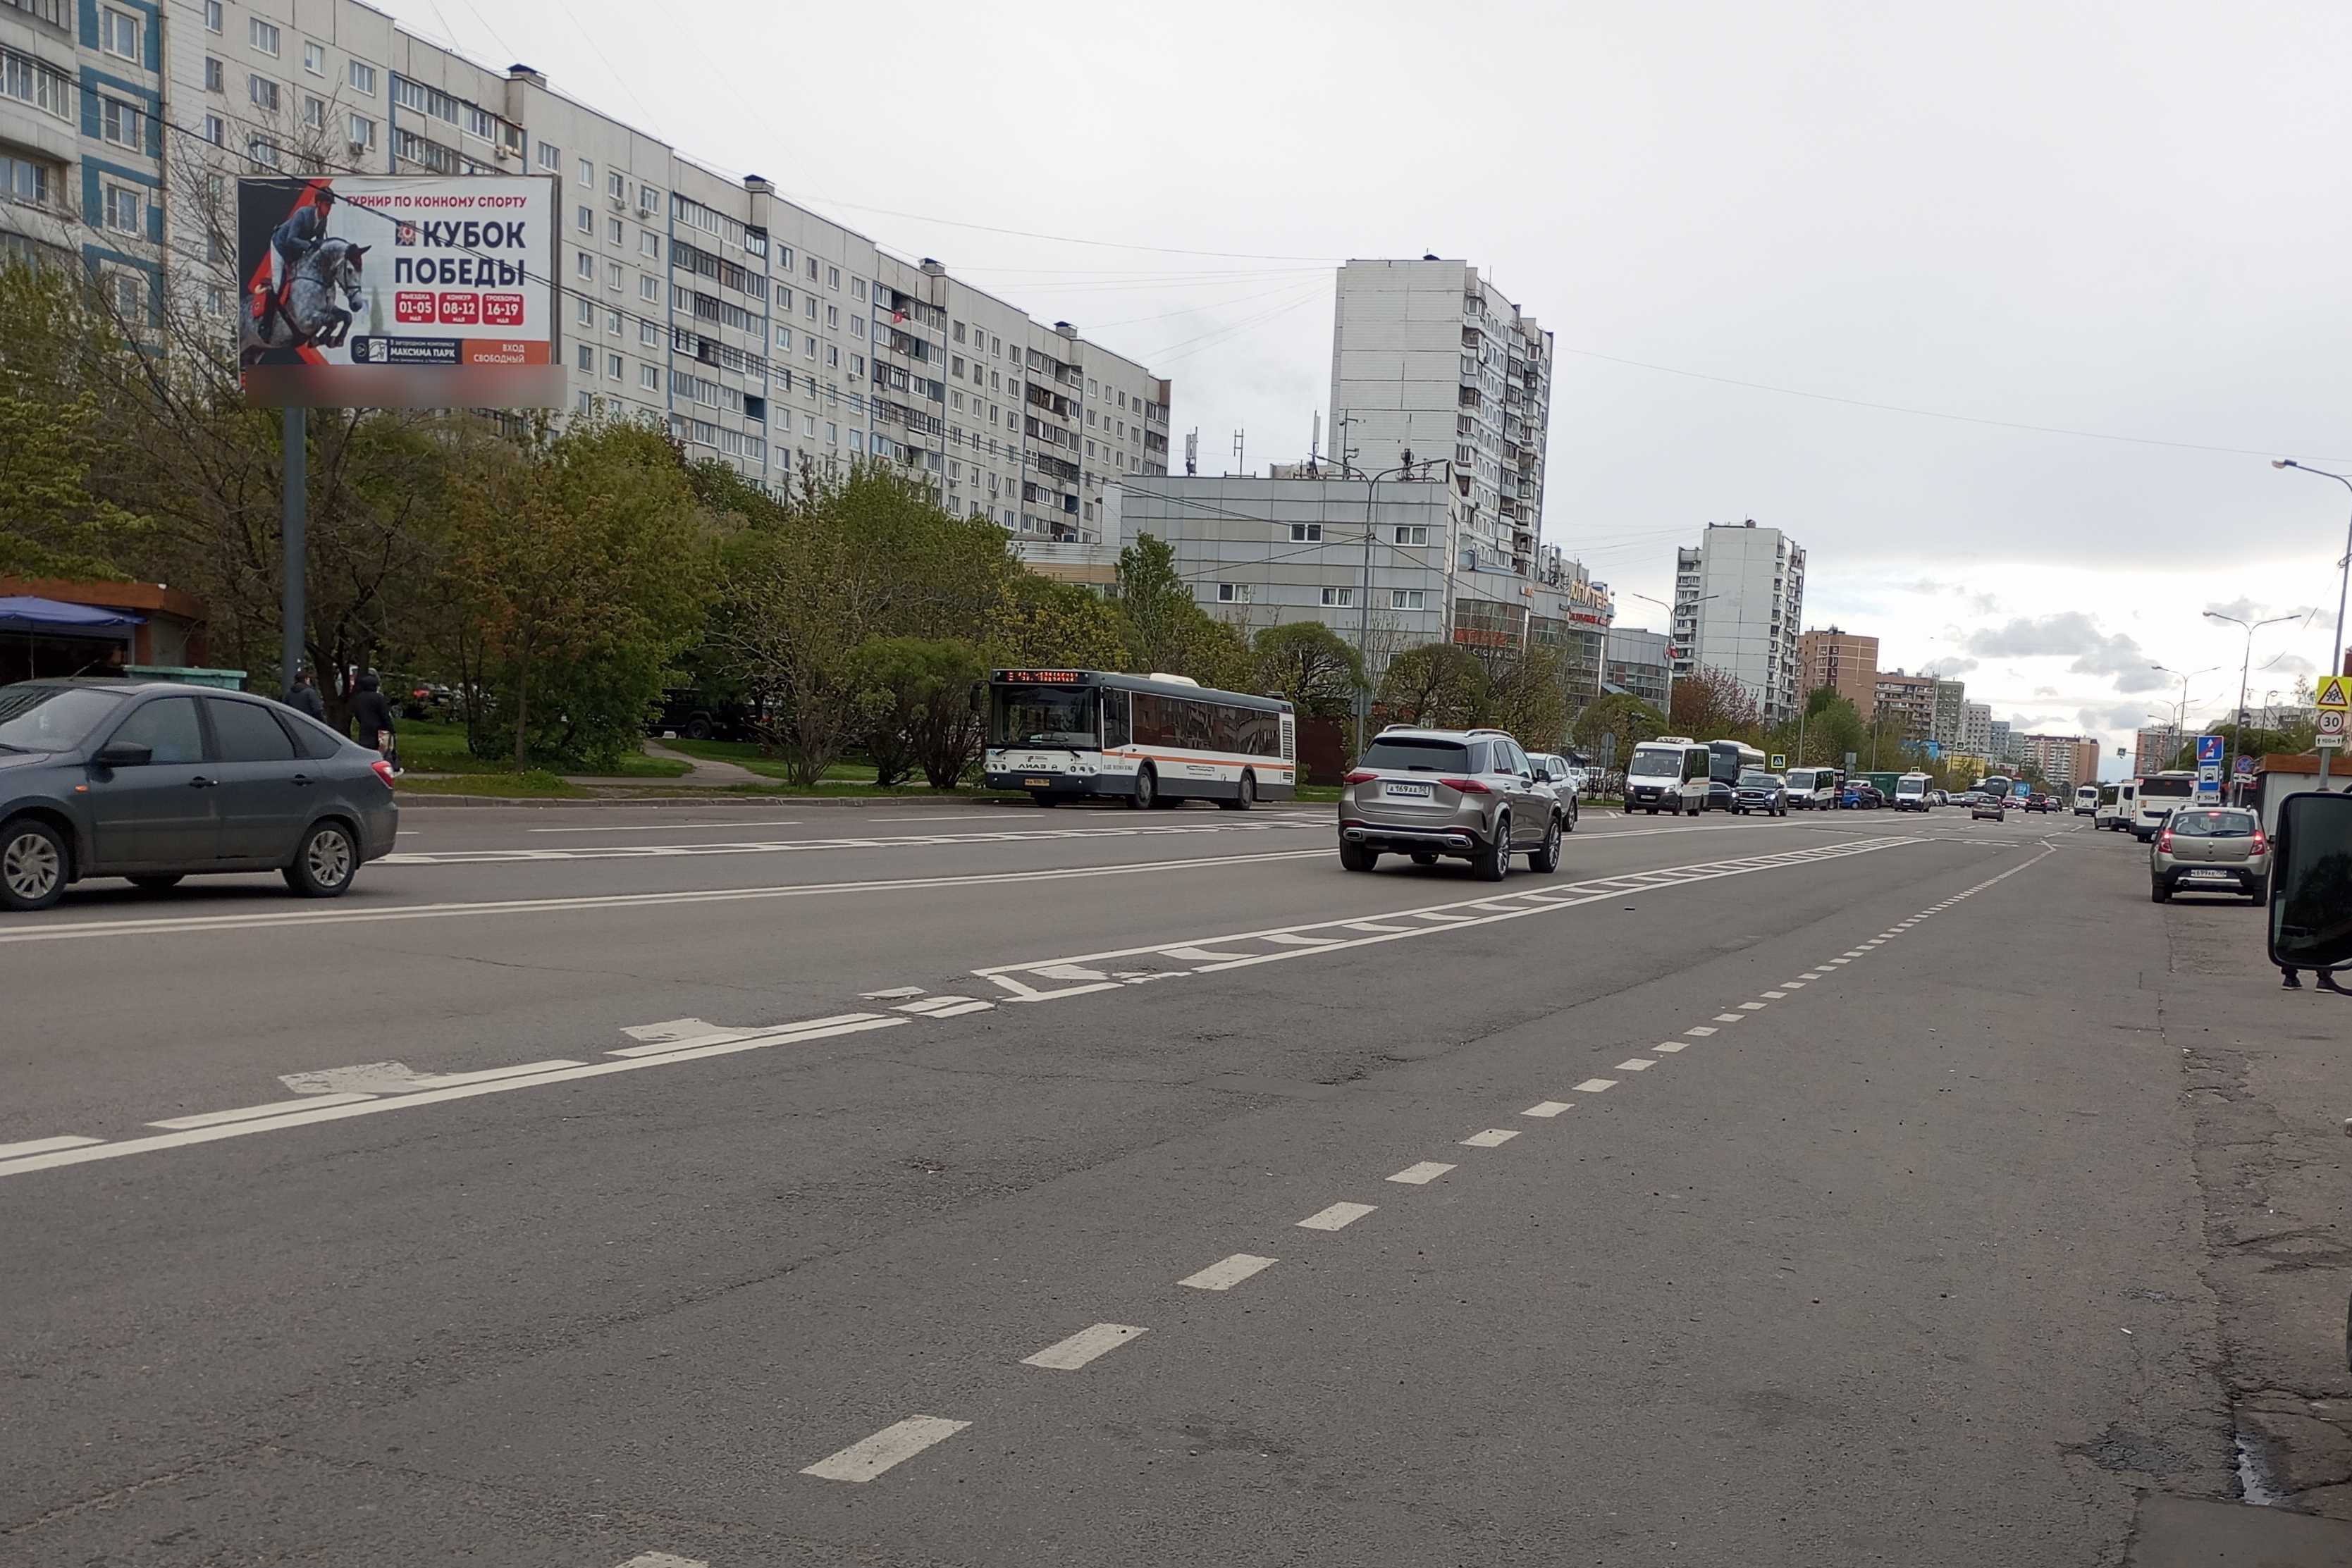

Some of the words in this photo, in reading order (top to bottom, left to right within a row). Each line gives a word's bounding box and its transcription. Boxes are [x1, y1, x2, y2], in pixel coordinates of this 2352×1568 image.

[345, 195, 392, 207] ТУРНИР
[395, 196, 412, 207] ПО
[414, 196, 476, 208] КОННОМУ
[478, 196, 527, 208] СПОРТУ
[423, 221, 527, 248] КУБОК
[395, 257, 525, 288] ПОБЕДЫ
[399, 301, 432, 314] 01-05
[443, 302, 476, 315] 08-12
[486, 303, 519, 316] 16-19
[390, 347, 431, 357] МАКСИМА
[432, 348, 455, 357] ПАРК
[502, 343, 525, 352] ВХОД
[473, 353, 525, 363] СВОБОДНЫЙ
[2323, 716, 2339, 727] 30
